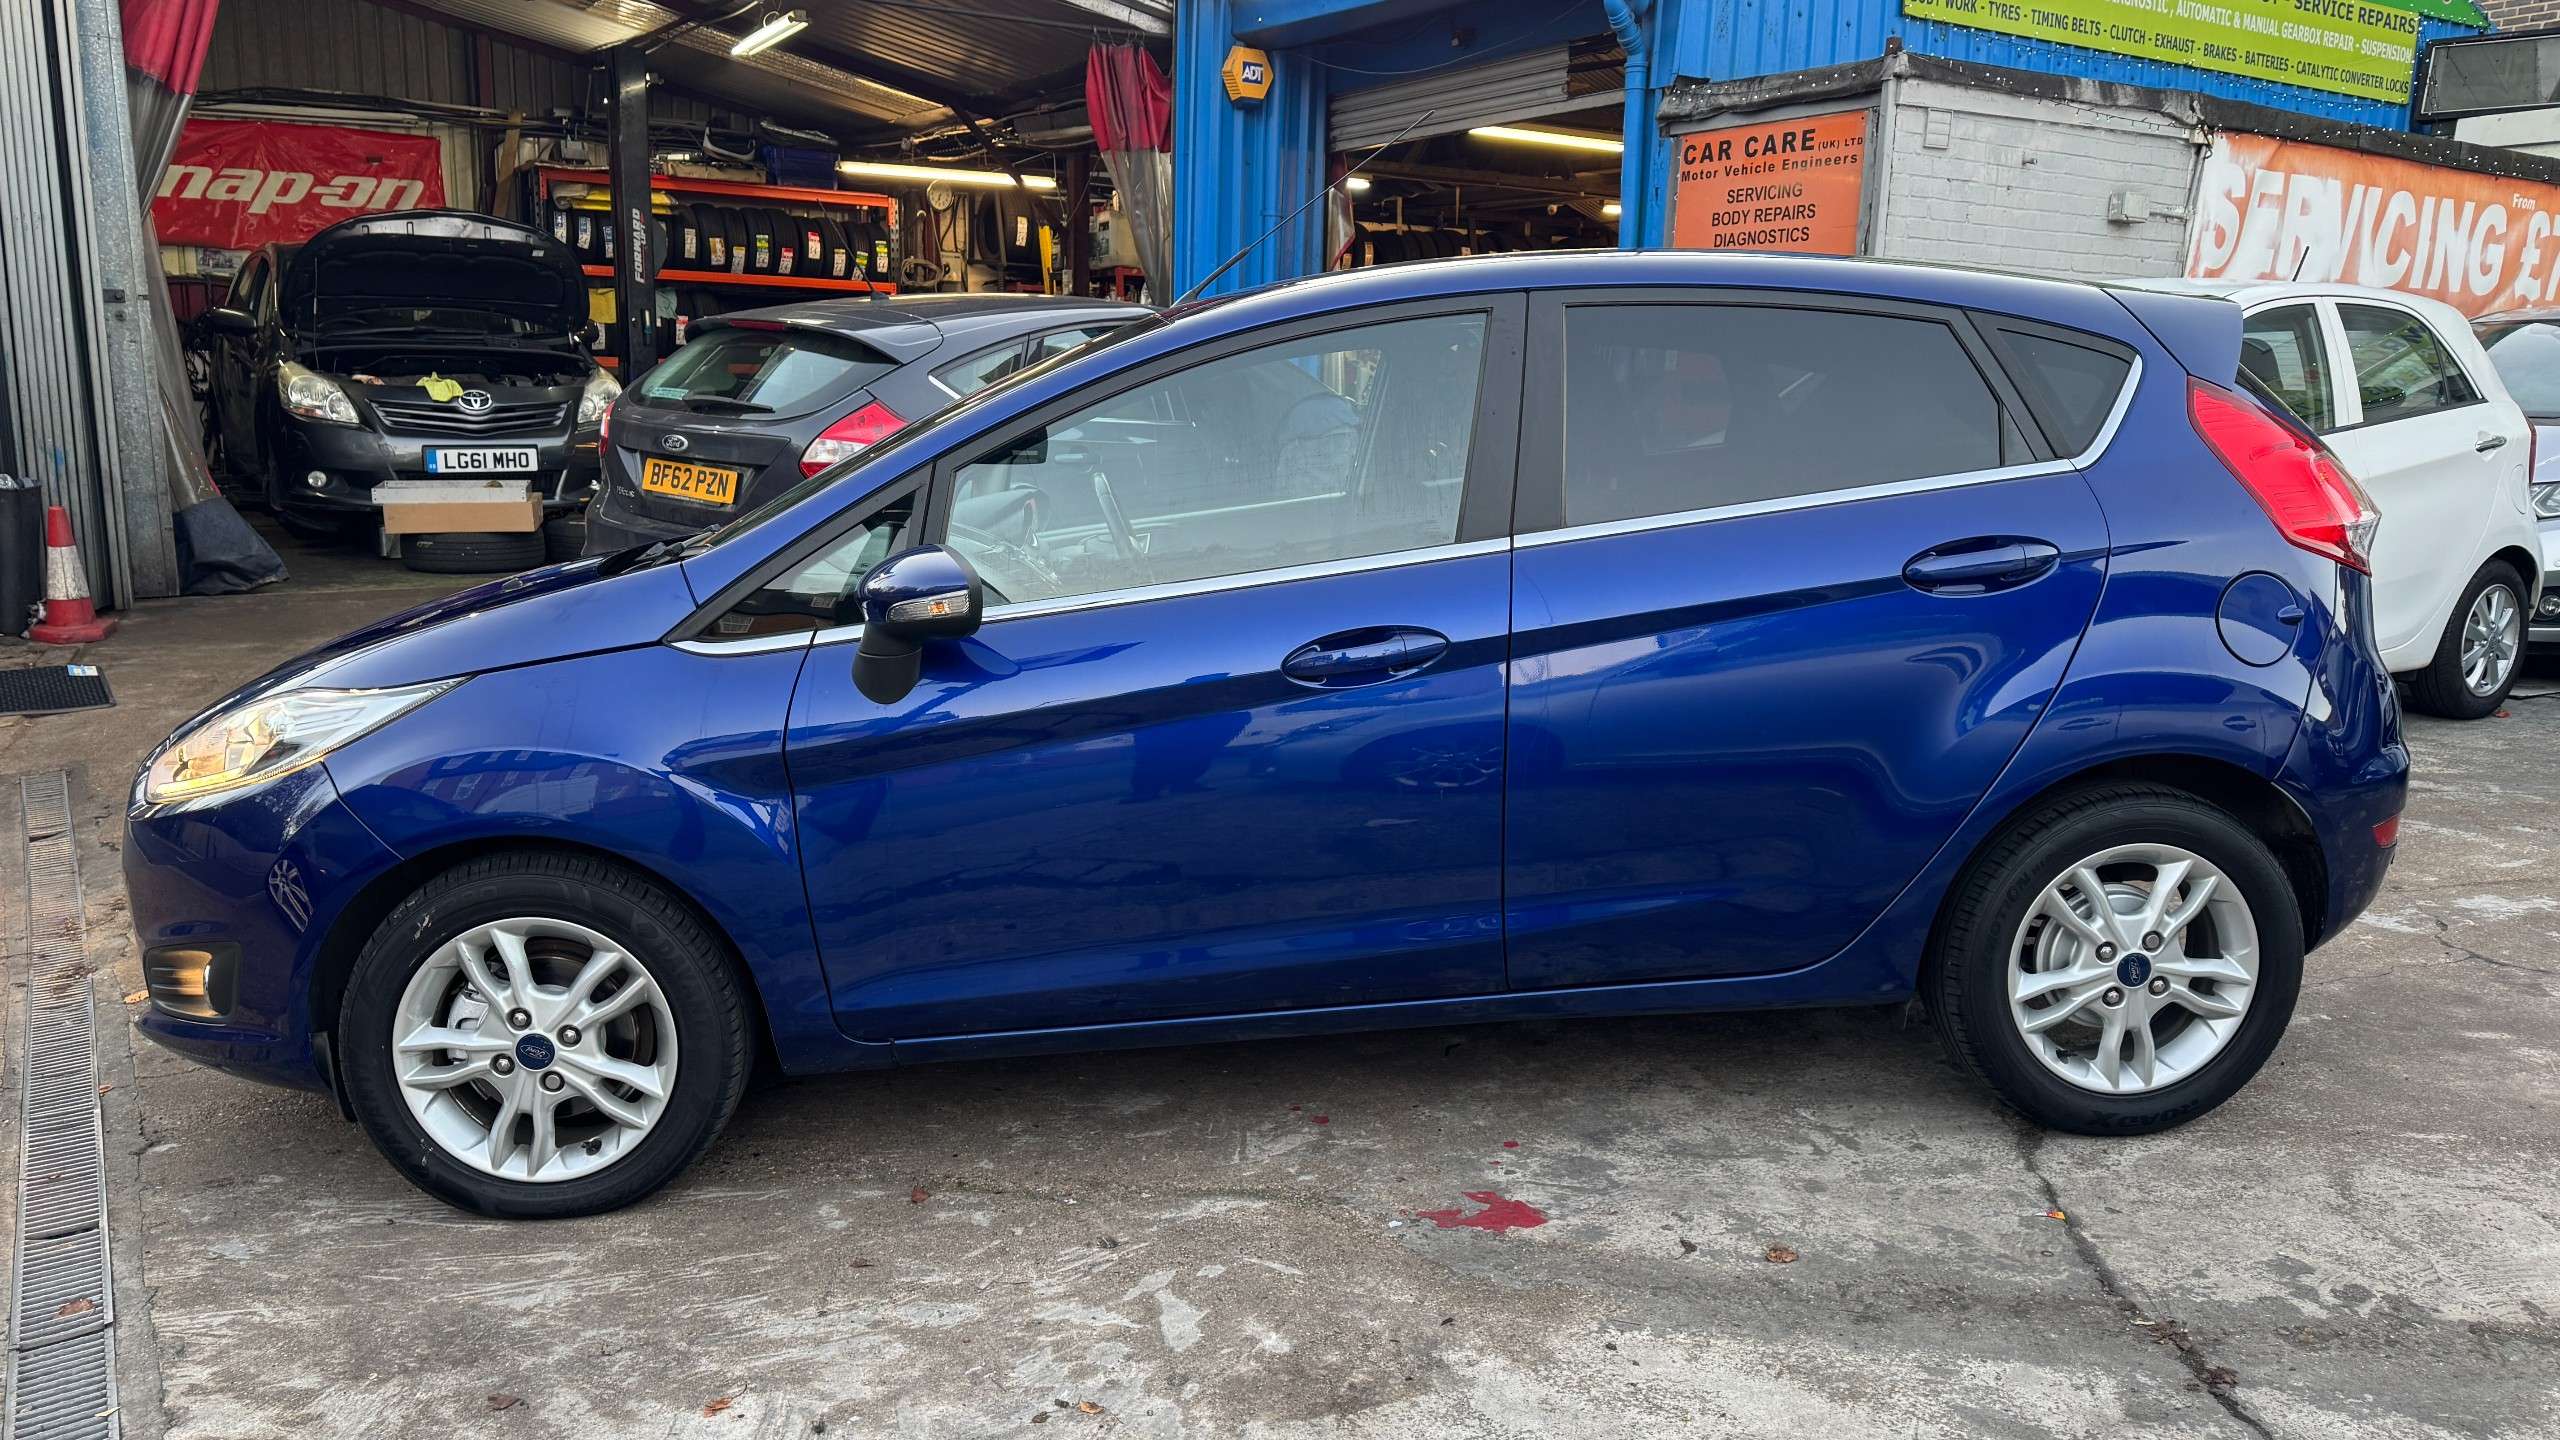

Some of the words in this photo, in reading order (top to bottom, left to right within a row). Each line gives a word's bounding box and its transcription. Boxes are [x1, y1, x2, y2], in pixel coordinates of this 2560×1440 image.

[2176, 0, 2232, 27] AUTOMATIC
[2232, 13, 2241, 29] &
[2242, 13, 2280, 37] MANUAL
[2281, 21, 2322, 46] GEARBOX
[2323, 31, 2354, 52] REPAIR
[2361, 38, 2413, 63] SUSPENSION
[2294, 0, 2355, 21] SERVICE
[2358, 7, 2417, 34] REPAIRS
[1945, 0, 1977, 14] WORK
[1988, 0, 2021, 21] TYRES
[2031, 9, 2069, 30] TIMING
[2072, 17, 2102, 36] BELTS
[2110, 24, 2146, 45] CLUTCH
[2155, 33, 2196, 54] EXHAUST
[2203, 42, 2237, 62] BRAKES
[2245, 51, 2289, 72] BATTERIES
[2296, 60, 2339, 80] CATALYTIC
[2340, 69, 2384, 89] CONVERTER
[2385, 78, 2410, 94] LOCKS
[1242, 65, 1264, 81] ADT
[1683, 140, 1732, 165] CAR
[1744, 129, 1816, 158] CARE
[1818, 138, 1840, 152] (UK)
[1844, 136, 1863, 147] LTD
[1681, 168, 1718, 182] Motor
[1724, 161, 1776, 177] Vehicle
[1782, 153, 1858, 171] Engineers
[156, 164, 424, 214] nap-on
[1726, 183, 1803, 204] SERVICING
[2512, 193, 2536, 210] From
[1711, 209, 1750, 227] BODY
[1753, 203, 1816, 223] REPAIRS
[2200, 164, 2508, 297] SERVICING
[632, 207, 645, 284] FORWARD
[1713, 226, 1810, 248] DIAGNOSTICS
[444, 452, 488, 469] LG61
[493, 452, 530, 468] MHO
[650, 463, 692, 489] BF62
[694, 470, 730, 498] PZN
